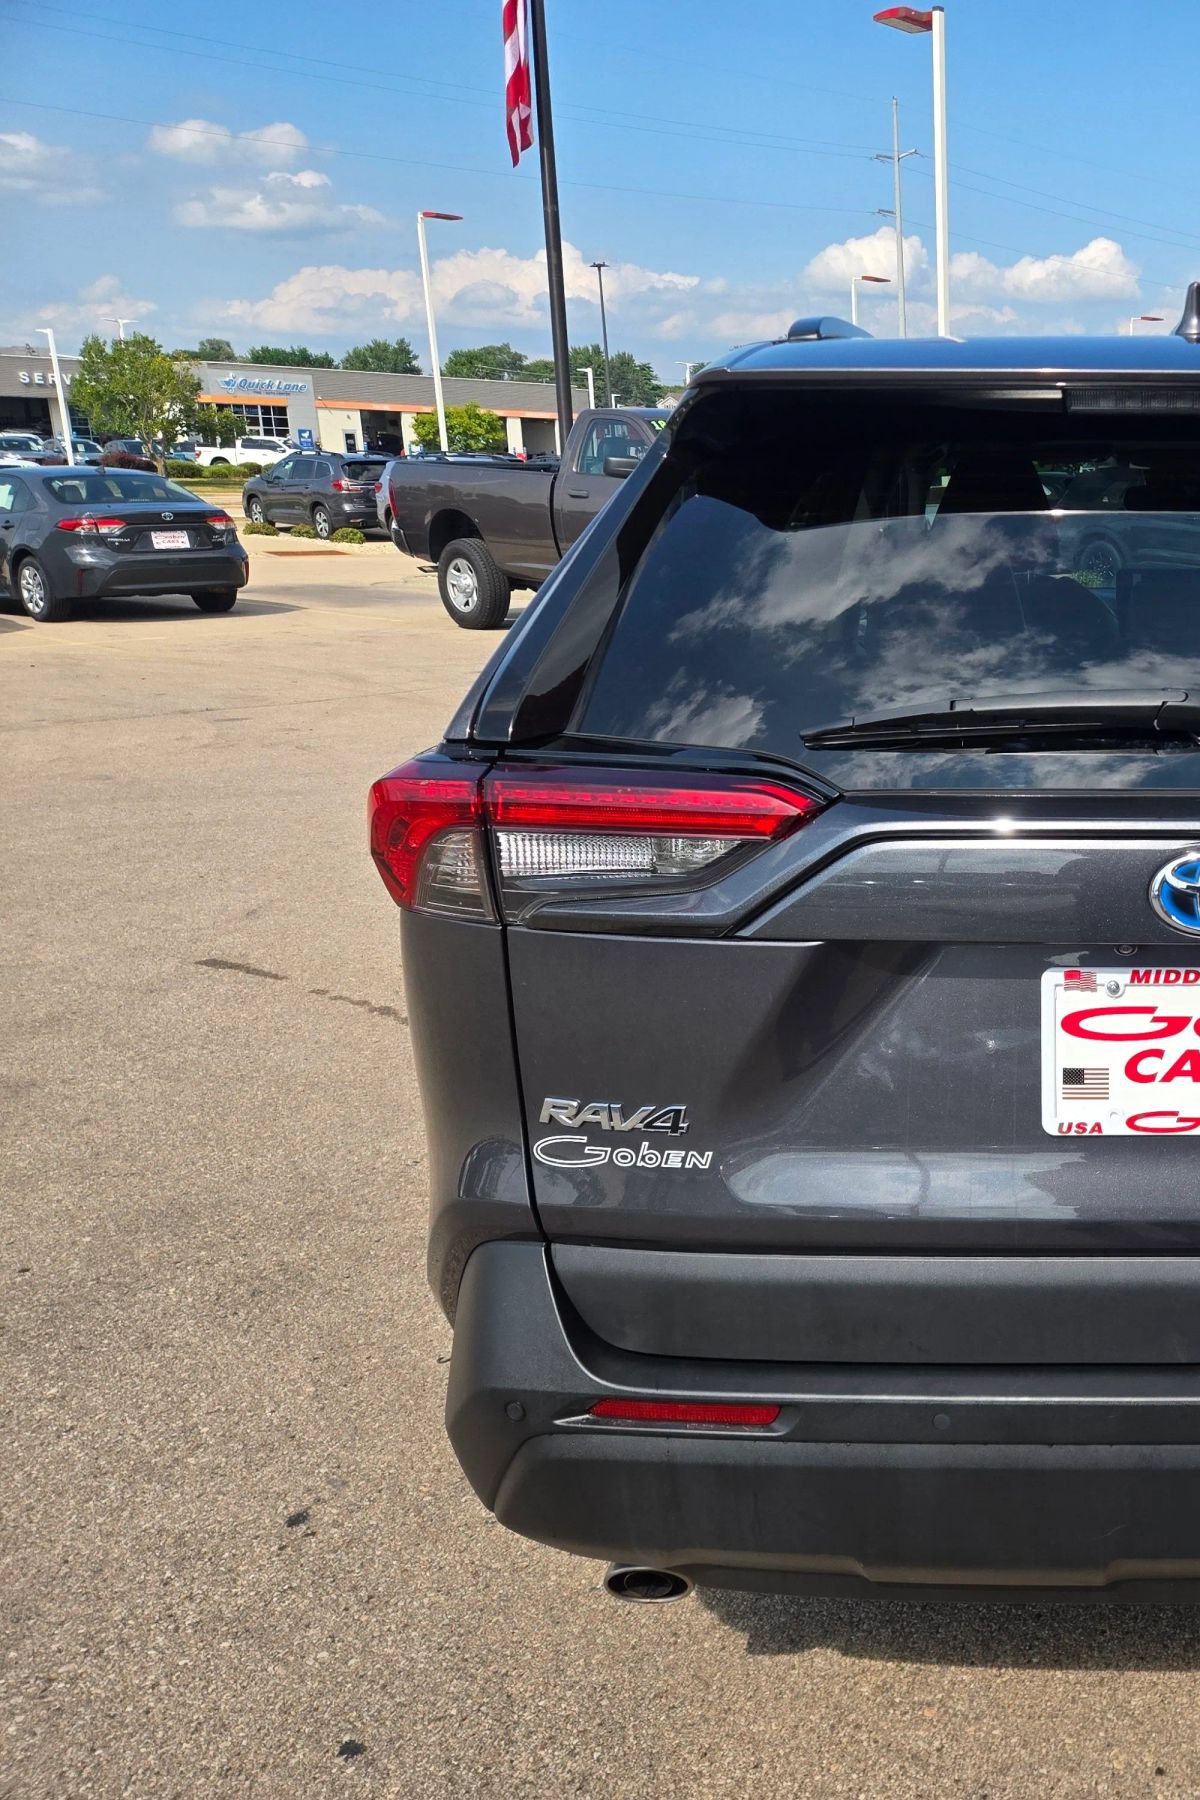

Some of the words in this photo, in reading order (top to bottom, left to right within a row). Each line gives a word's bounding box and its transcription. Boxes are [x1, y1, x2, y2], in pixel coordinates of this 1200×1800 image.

[239, 378, 273, 391] Quick
[276, 379, 308, 392] Lane
[539, 1097, 690, 1136] RAV4
[1058, 1122, 1103, 1135] USA
